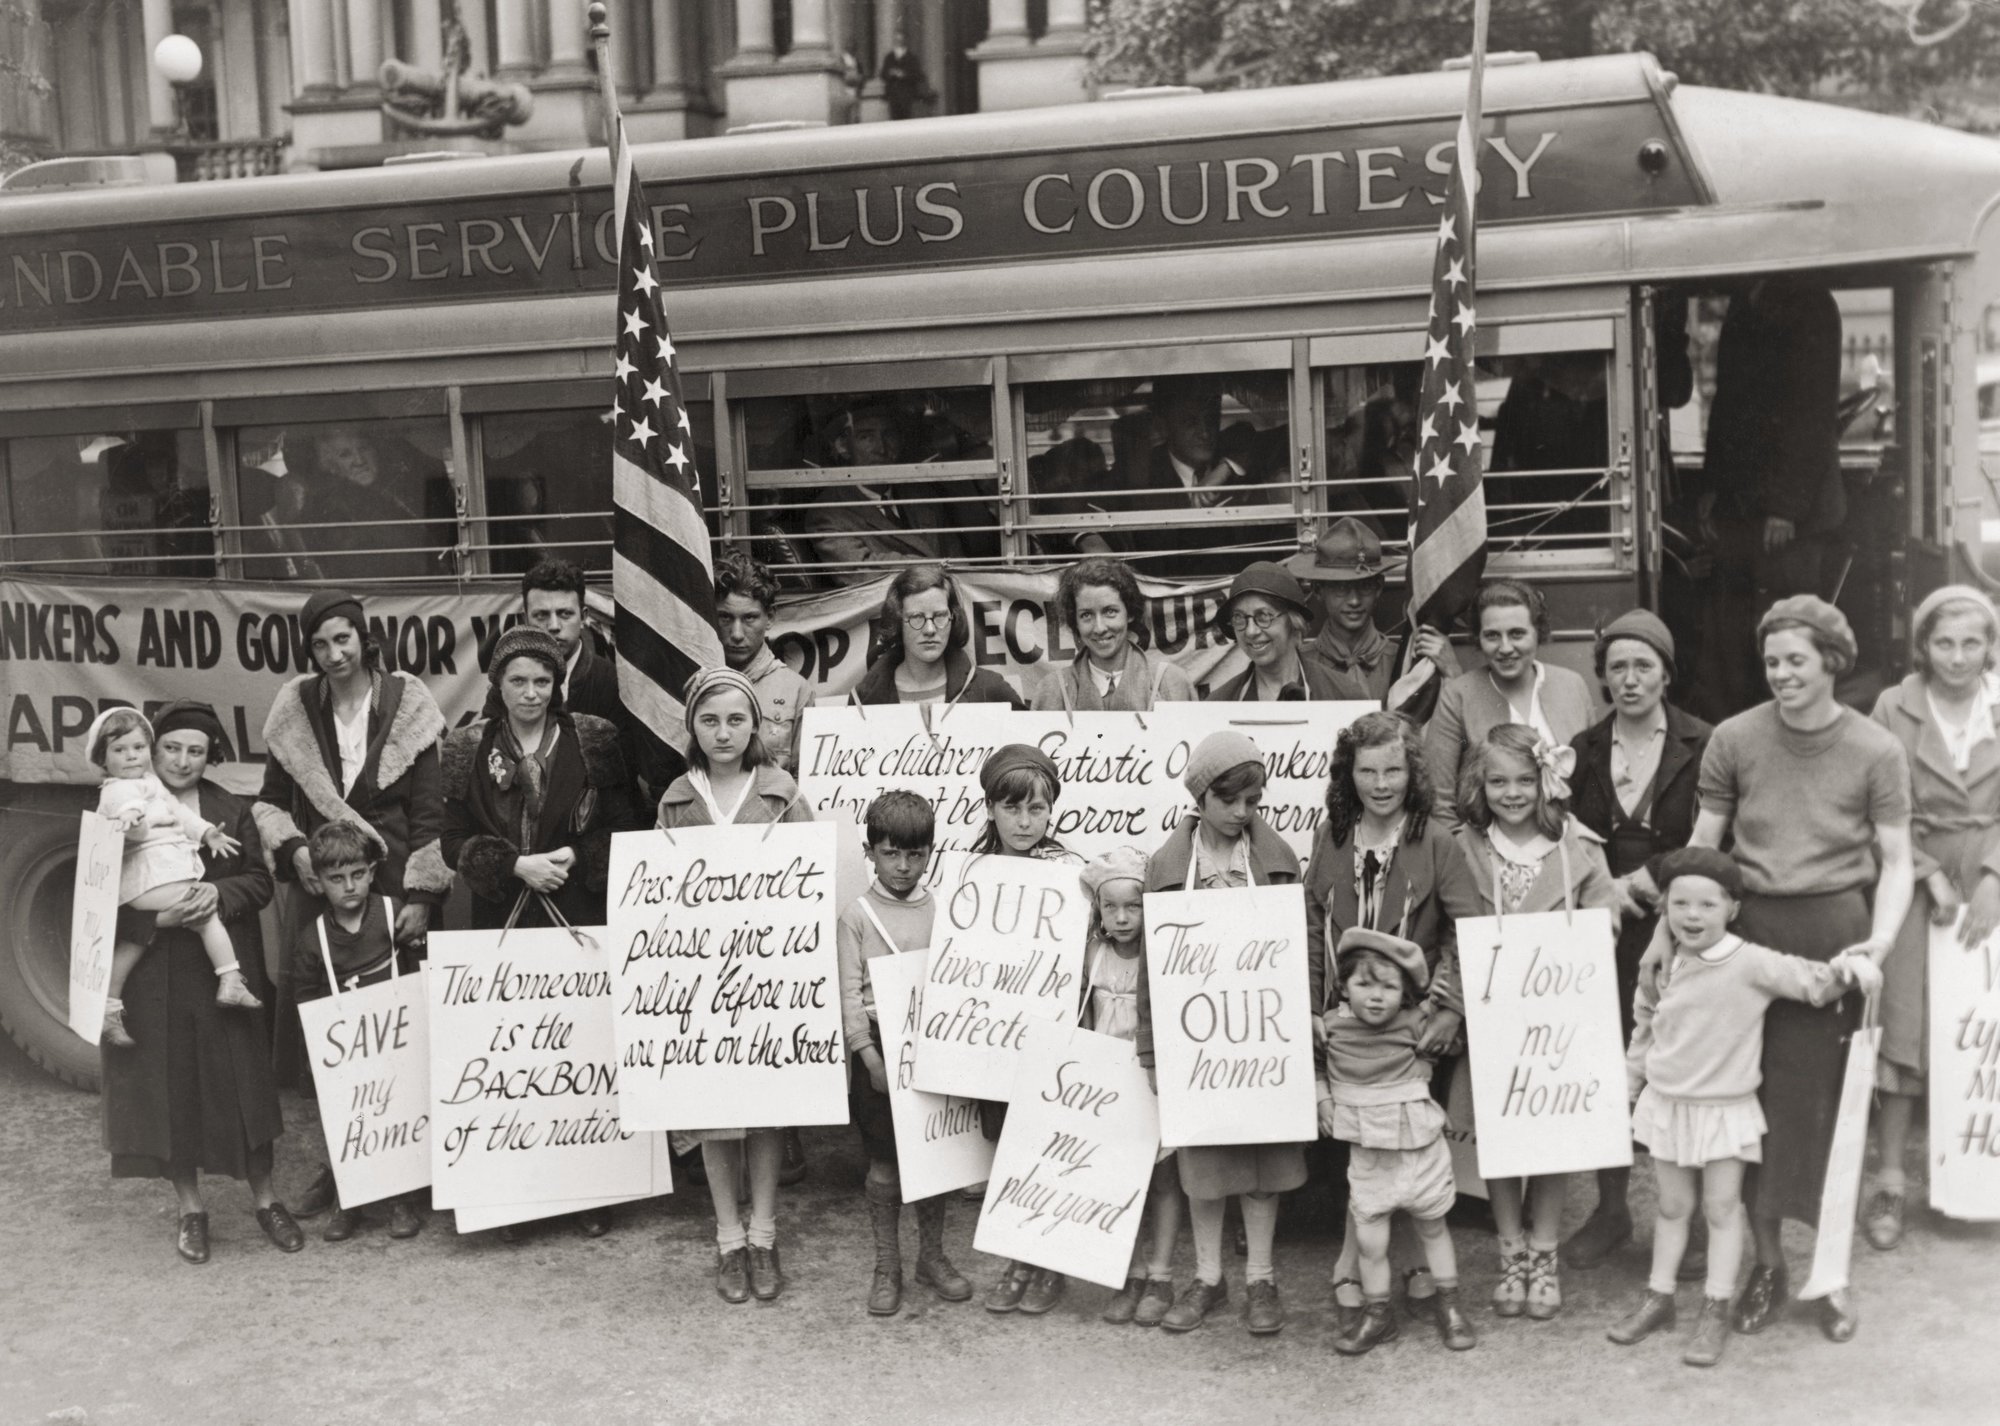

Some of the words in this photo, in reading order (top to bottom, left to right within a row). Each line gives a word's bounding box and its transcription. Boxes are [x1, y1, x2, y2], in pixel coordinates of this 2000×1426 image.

[0, 233, 294, 308] NDABLE
[745, 182, 966, 258] PLUS
[1022, 131, 1559, 236] COURTESY
[0, 600, 121, 665] NKERS
[137, 607, 222, 670] AND
[236, 612, 457, 675] GOVNOR
[809, 733, 875, 777] These
[946, 785, 986, 826] be
[1052, 805, 1148, 841] prove
[618, 860, 673, 909] Pres.
[674, 856, 825, 908] Roosevelt,
[949, 881, 1066, 942] OUR
[621, 912, 712, 976] please
[717, 920, 775, 980] give
[782, 920, 820, 954] us
[930, 937, 991, 989] lives
[993, 949, 1044, 996] will
[1037, 953, 1073, 999] be
[1154, 921, 1220, 987] They
[1236, 938, 1290, 972] are
[442, 964, 482, 1005] The
[486, 961, 612, 1002] Homeown
[621, 971, 702, 1034] relief
[710, 964, 784, 1028] before
[789, 976, 827, 1009] we
[1481, 944, 1503, 1004] I
[1520, 945, 1596, 998] love
[322, 1004, 409, 1069] SAVE
[489, 1017, 525, 1052] is
[531, 1012, 574, 1051] the
[925, 997, 1065, 1051] affecte
[1180, 987, 1291, 1044] OUR
[623, 1037, 655, 1069] are
[660, 1028, 709, 1081] put
[714, 1035, 745, 1066] on
[747, 1022, 786, 1069] the
[783, 1022, 846, 1066] Street.
[1187, 1047, 1291, 1091] homes
[1519, 1022, 1578, 1071] my
[351, 1075, 398, 1117] my
[440, 1057, 619, 1105] BACKBON
[1041, 1060, 1119, 1117] Save
[1501, 1065, 1601, 1118] Home
[340, 1113, 430, 1164] Home
[443, 1116, 479, 1168] of
[486, 1109, 541, 1152] the
[1041, 1131, 1101, 1177] my
